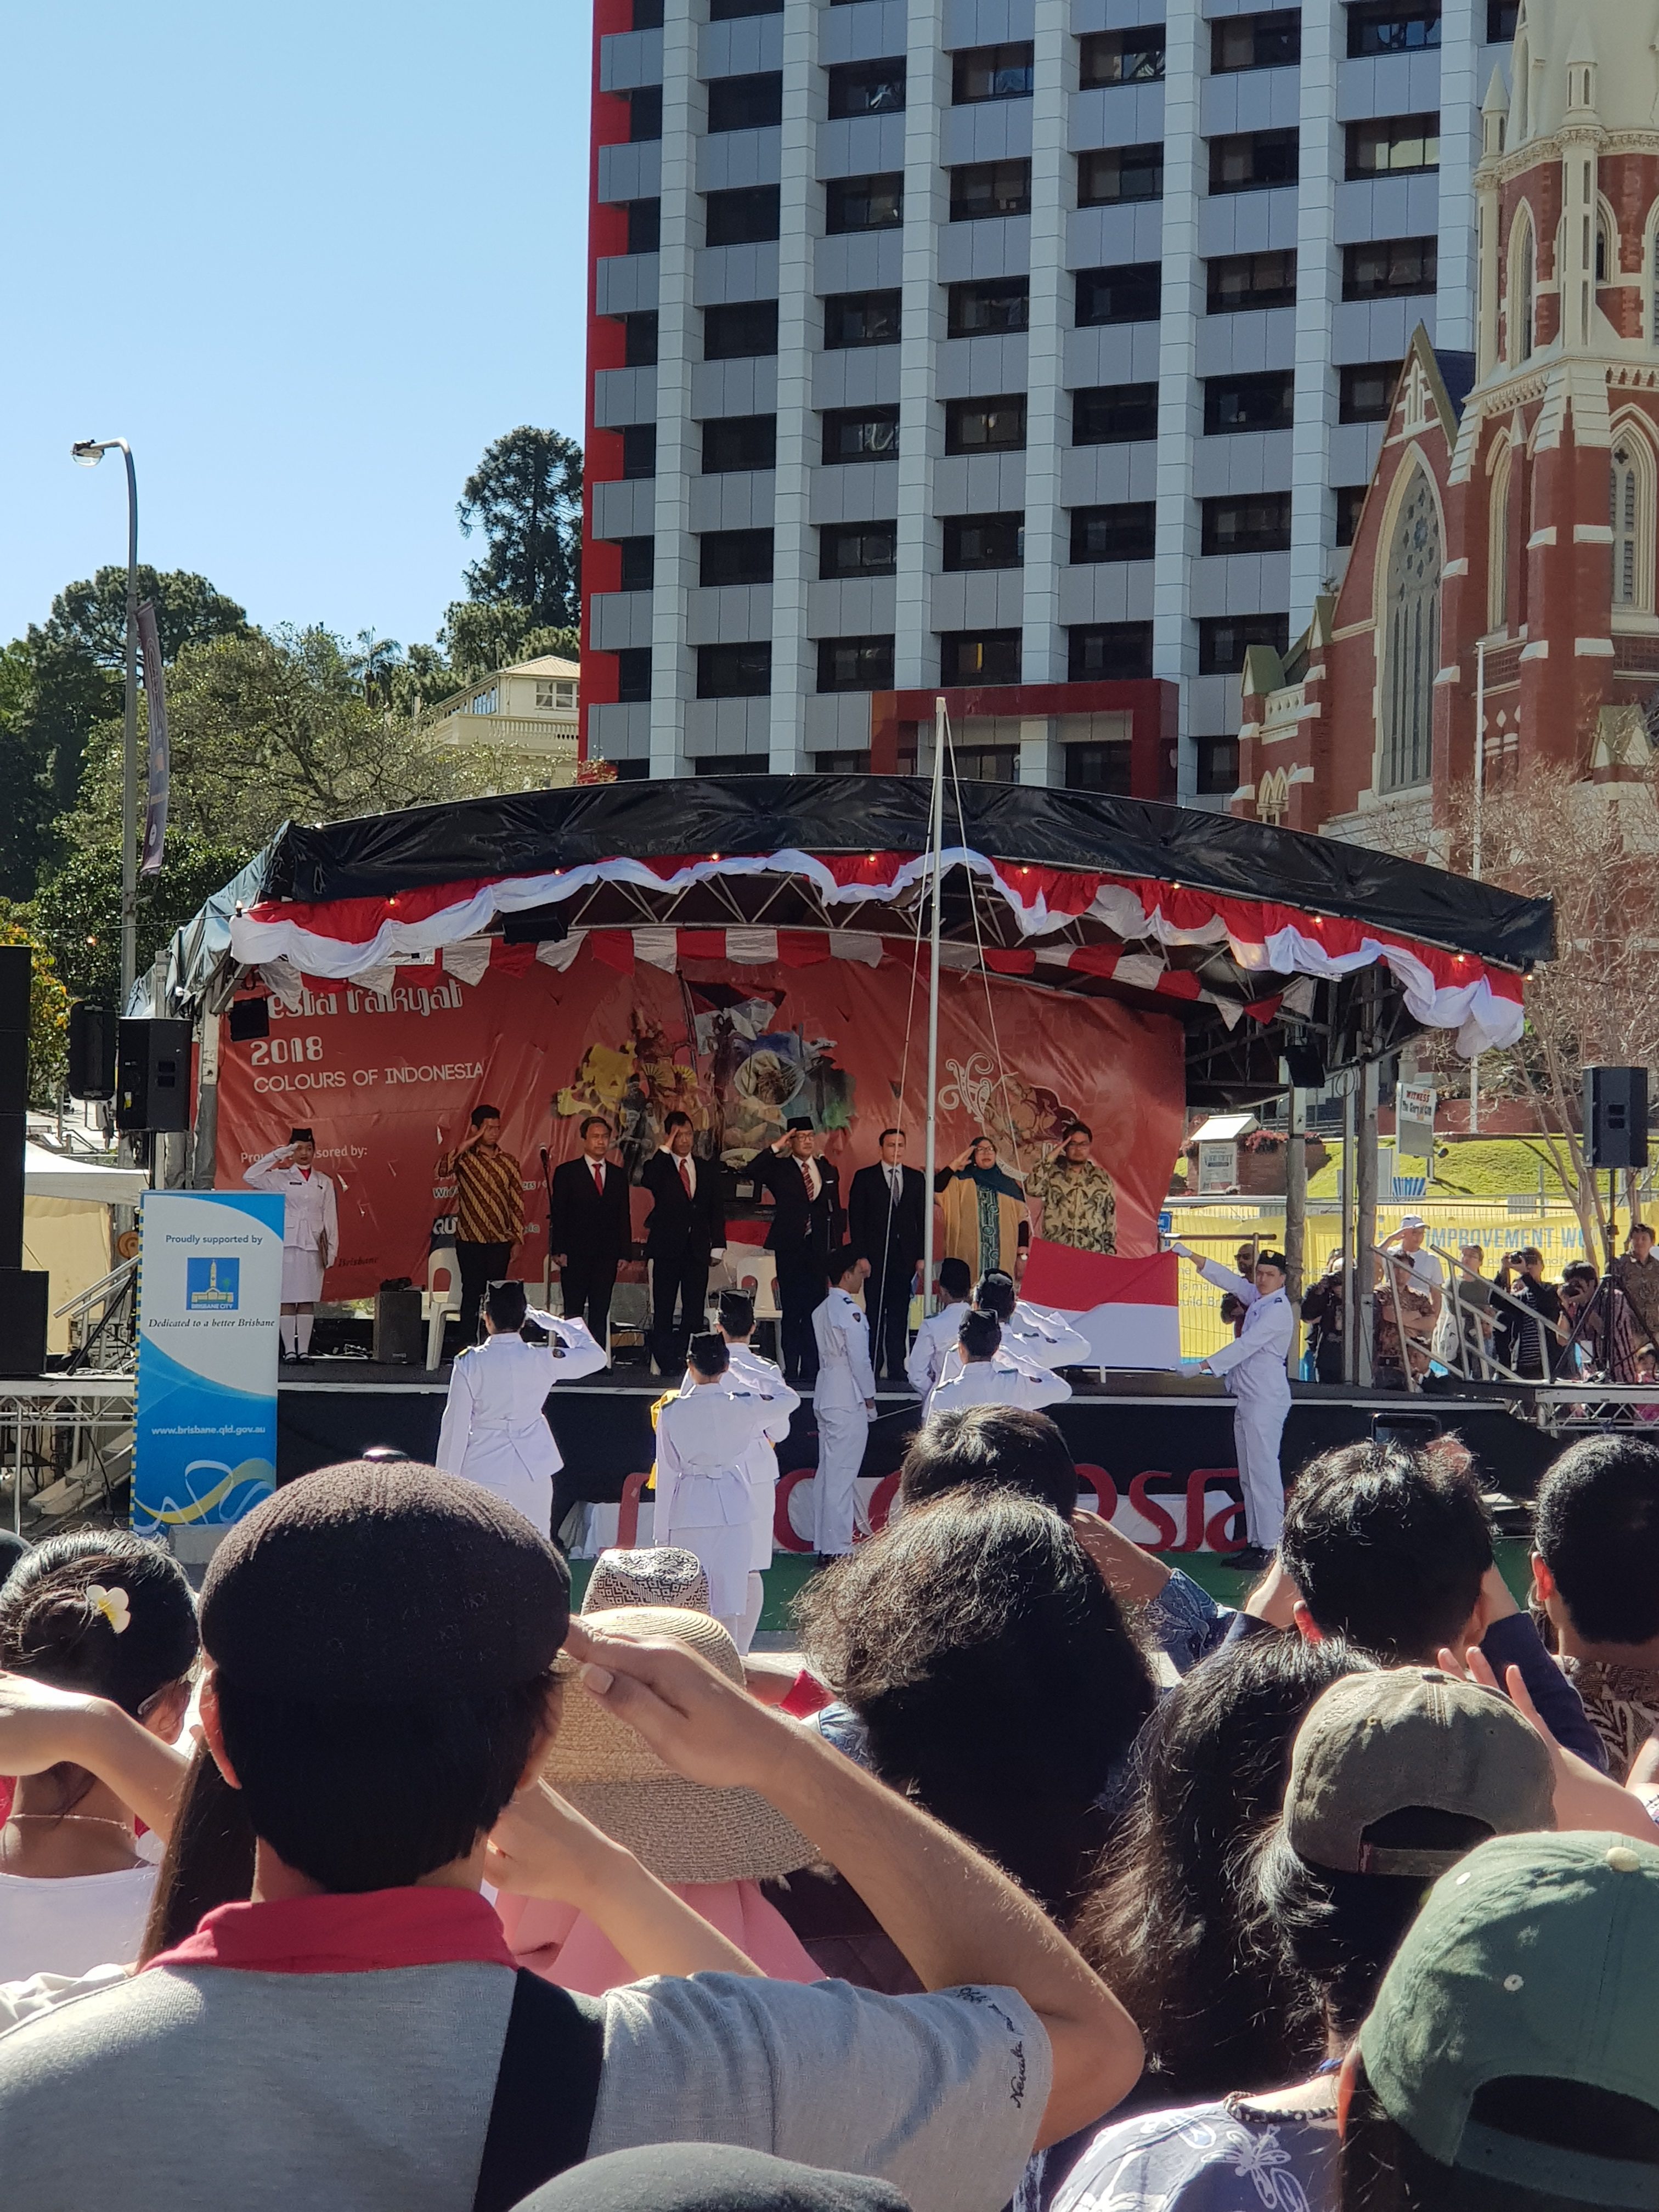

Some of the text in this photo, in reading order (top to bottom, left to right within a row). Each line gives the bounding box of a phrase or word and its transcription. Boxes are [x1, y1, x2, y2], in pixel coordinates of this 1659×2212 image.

[251, 1036, 323, 1066] 2018
[253, 1063, 483, 1093] COLOURS OF INDONESIA
[1406, 1090, 1430, 1103] WITNESS
[351, 1144, 368, 1159] by:
[166, 1234, 263, 1245] Proudly supported by
[1426, 1227, 1554, 1249] IMPROVEMENT
[149, 1319, 190, 1327] Dedicated
[212, 1319, 236, 1327] better
[238, 1319, 275, 1327] Brisbane
[151, 1425, 266, 1436] www.brisbane.qld.gov.au
